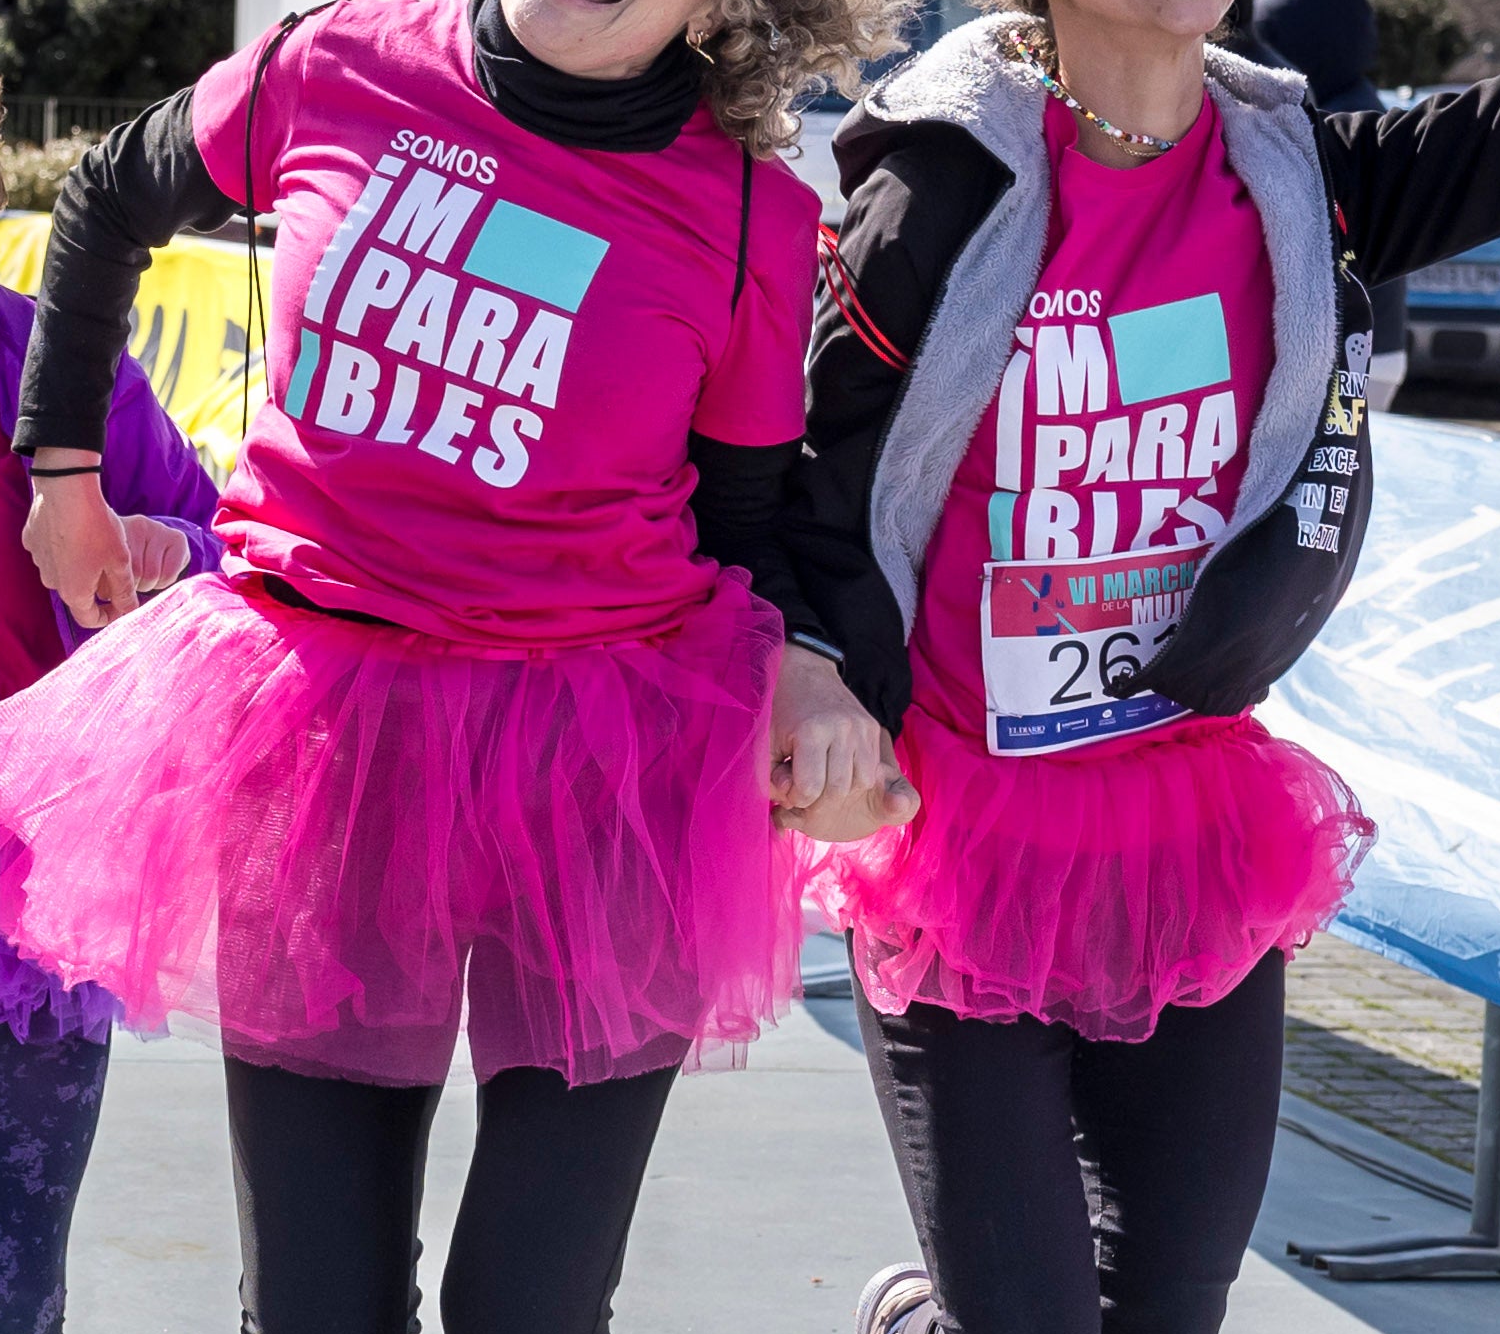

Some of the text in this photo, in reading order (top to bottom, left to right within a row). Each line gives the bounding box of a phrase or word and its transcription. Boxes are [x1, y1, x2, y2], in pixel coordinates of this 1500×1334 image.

[390, 129, 498, 185] SOMOS
[335, 247, 574, 409] PARA
[315, 339, 545, 489] BLES
[1034, 390, 1238, 489] PARA
[1300, 483, 1327, 510] IN
[1067, 557, 1203, 607] VI MARCH
[1101, 601, 1115, 612] DE
[1117, 599, 1130, 610] LA
[1048, 622, 1178, 707] 26
